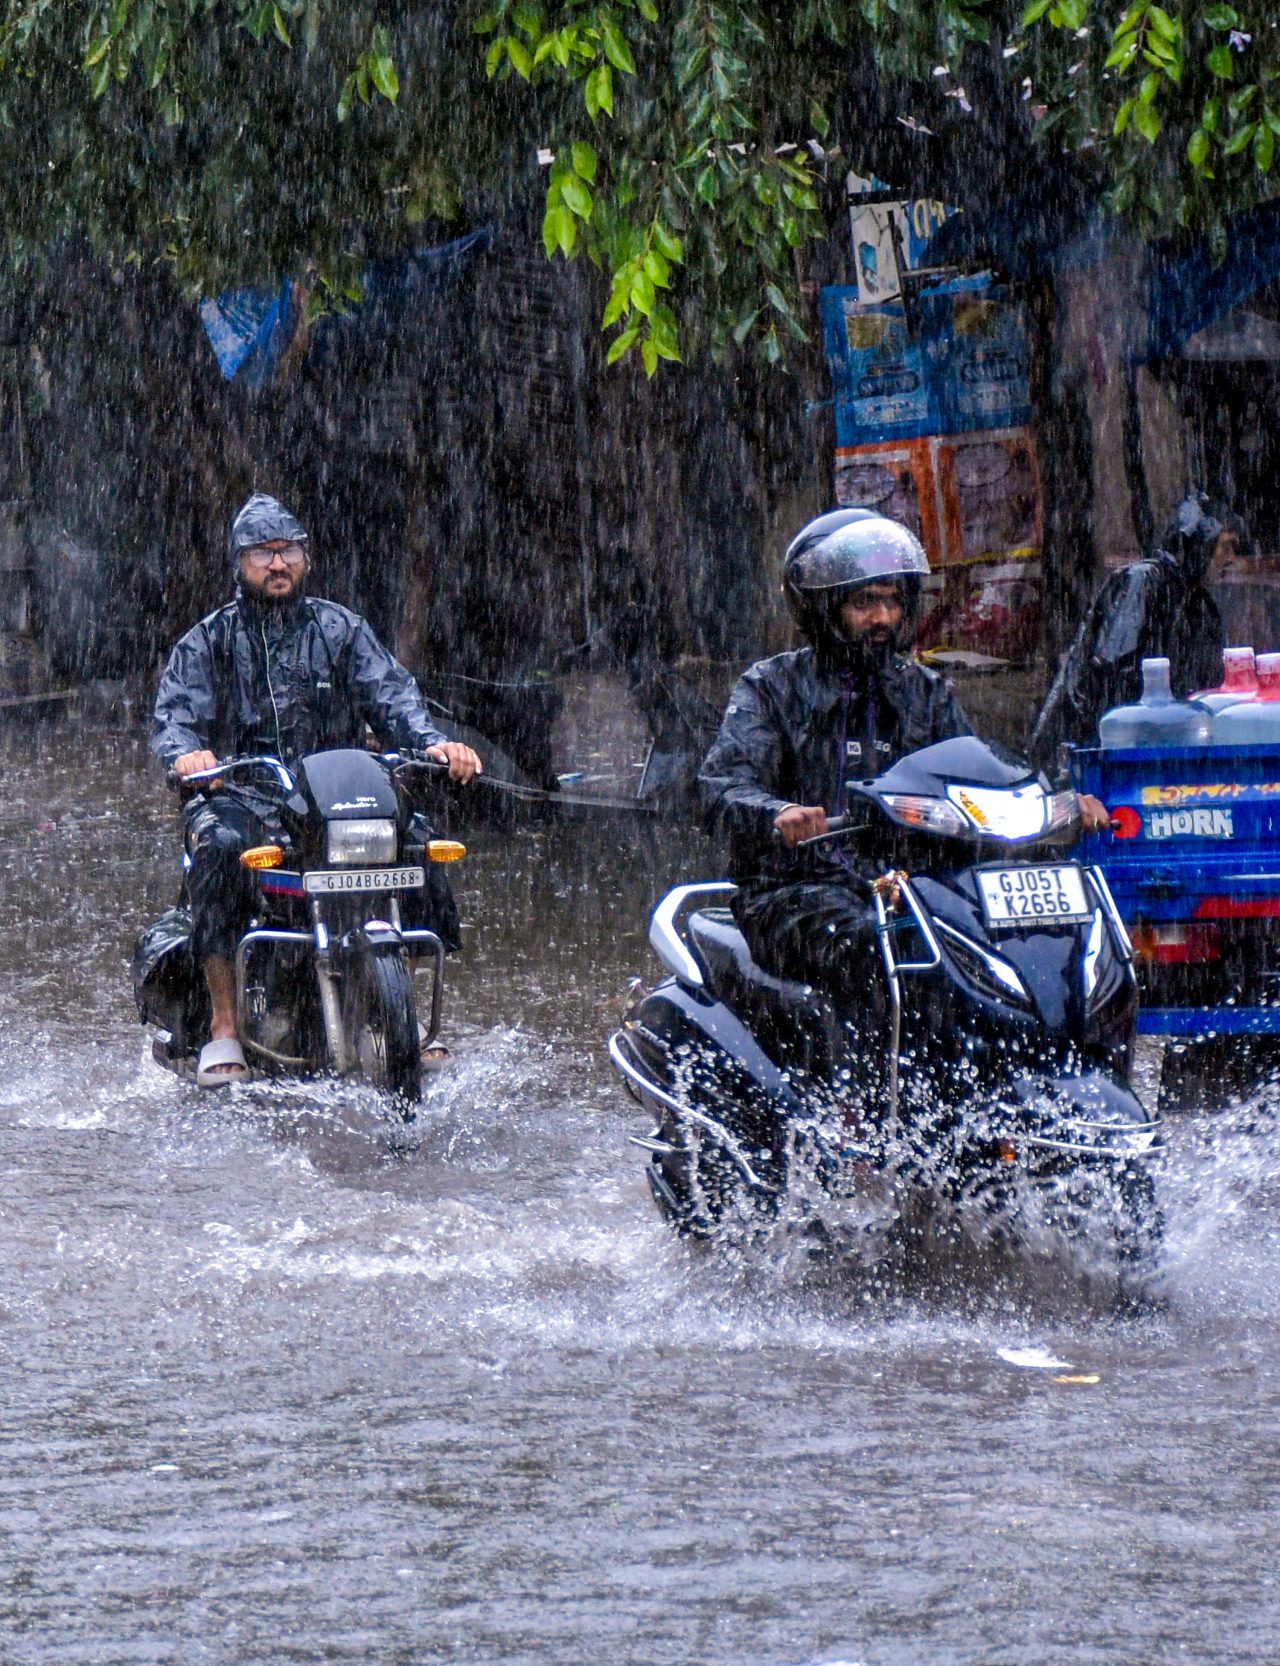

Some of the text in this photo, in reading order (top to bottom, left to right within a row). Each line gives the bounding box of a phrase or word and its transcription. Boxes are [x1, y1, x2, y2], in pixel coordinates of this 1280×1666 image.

[1151, 809, 1234, 837] HORN
[327, 871, 415, 889] GJ04BG2668
[999, 869, 1063, 893] GJ05T
[1004, 892, 1071, 916] K2656
